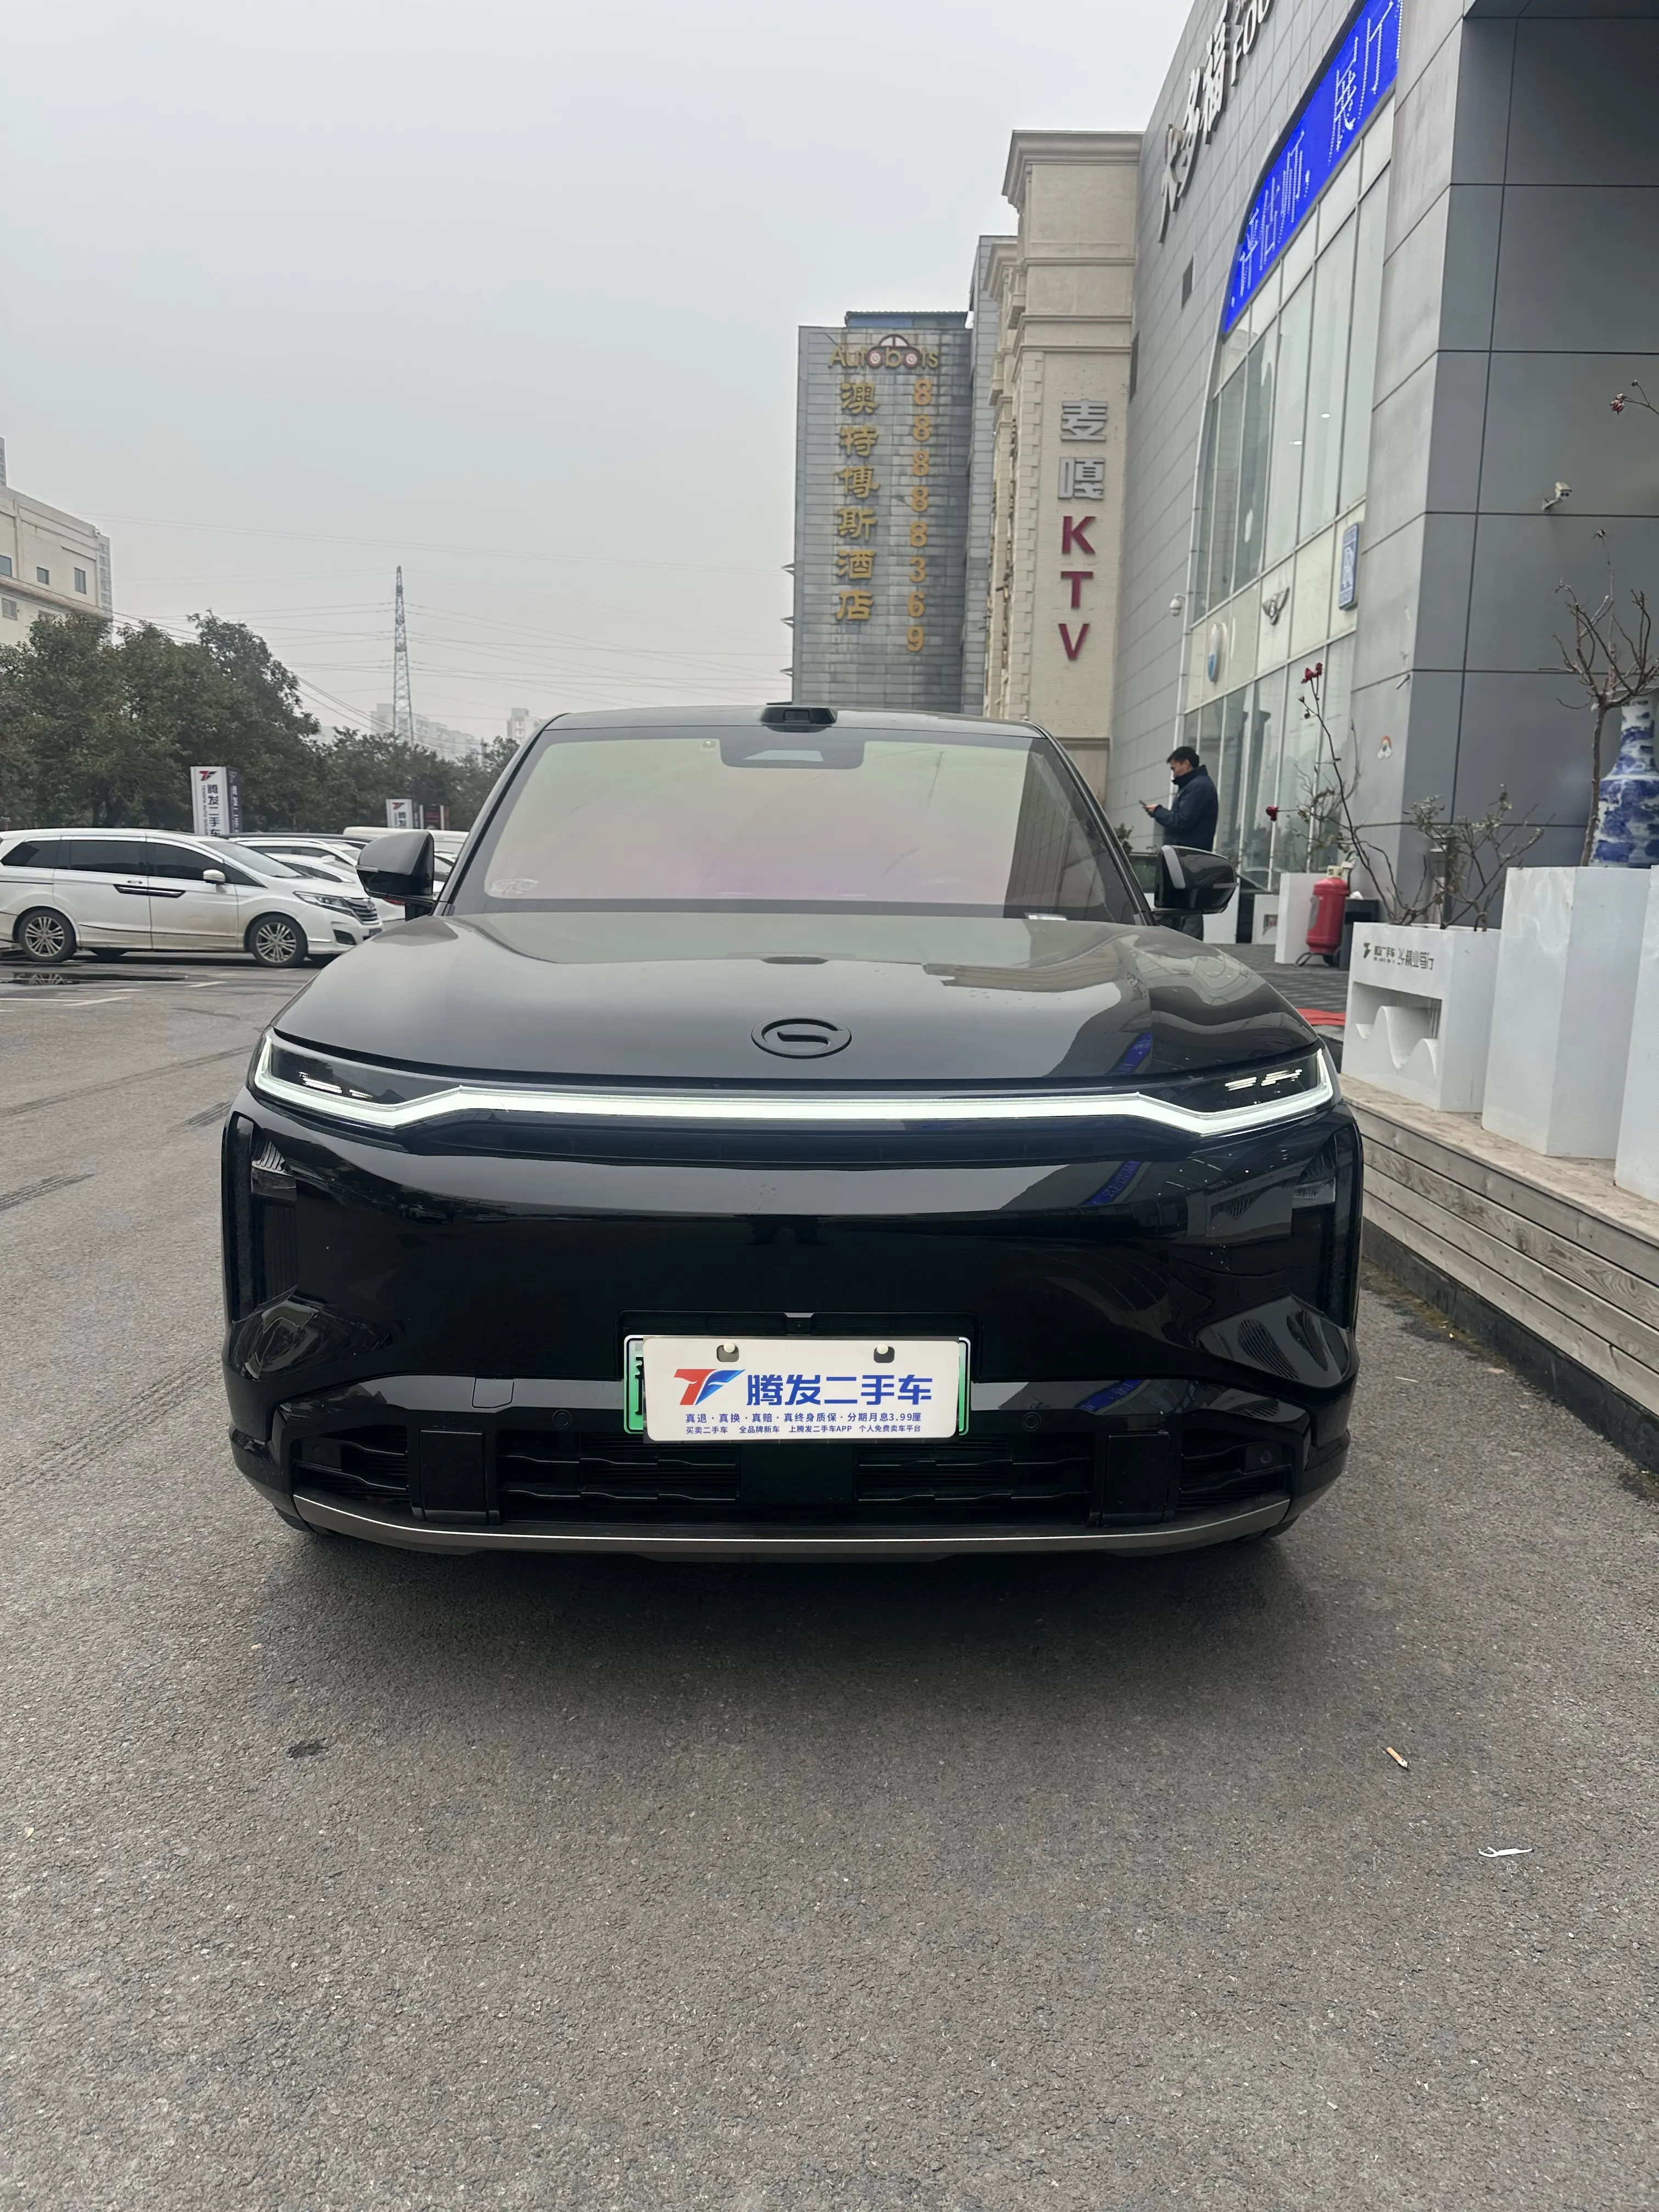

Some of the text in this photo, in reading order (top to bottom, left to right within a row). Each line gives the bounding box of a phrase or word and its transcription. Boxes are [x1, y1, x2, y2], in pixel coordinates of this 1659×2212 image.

[828, 345, 939, 368] Autobots
[835, 381, 881, 622] 澳特博斯酒店
[906, 379, 933, 653] 88888369
[746, 1374, 933, 1406] 腾发二手车
[859, 1424, 921, 1432] 个人免费卖车平台
